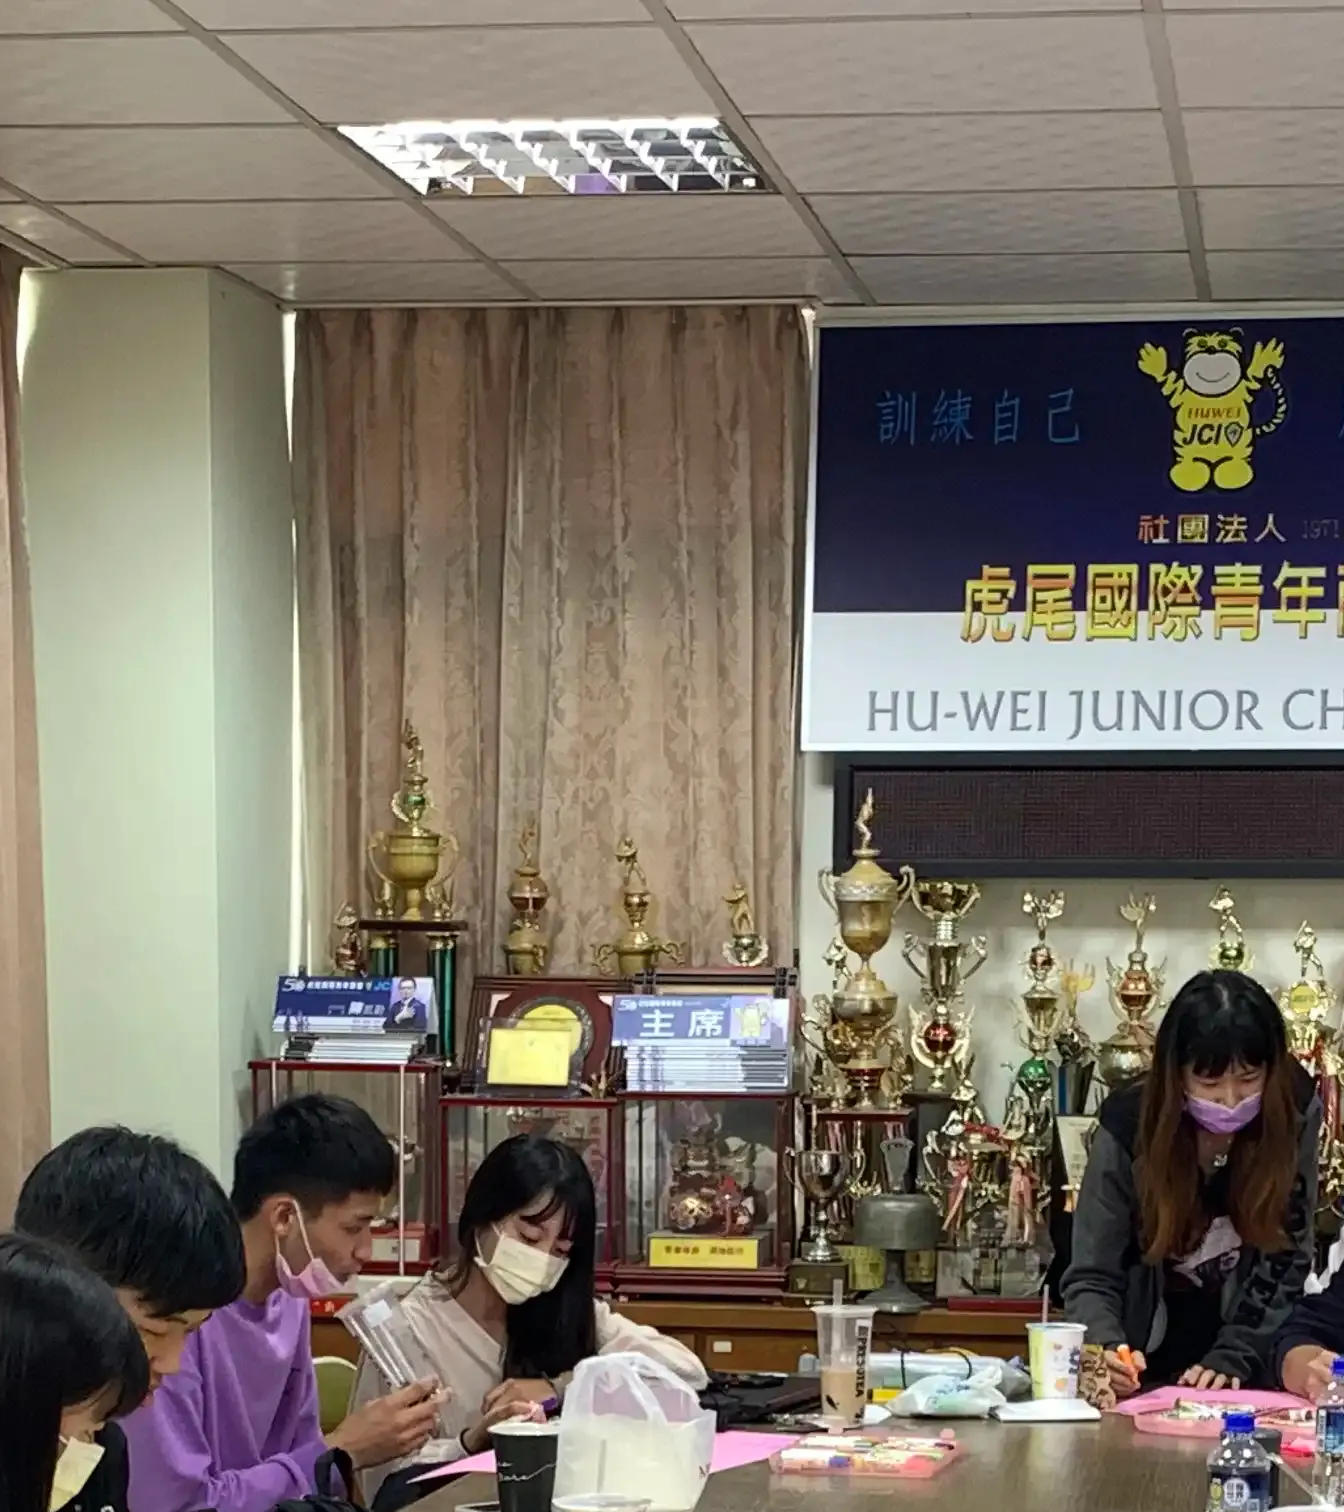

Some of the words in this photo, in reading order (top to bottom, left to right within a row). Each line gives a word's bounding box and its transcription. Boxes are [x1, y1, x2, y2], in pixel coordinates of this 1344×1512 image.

[876, 389, 1082, 447] 訓練自己
[1187, 407, 1242, 419] HUWEI
[1182, 423, 1224, 446] JCI
[1137, 513, 1287, 545] 社團法人
[867, 691, 1047, 733] HU-WEI
[1066, 689, 1260, 741] JUNIOR
[640, 1009, 724, 1037] 主席
